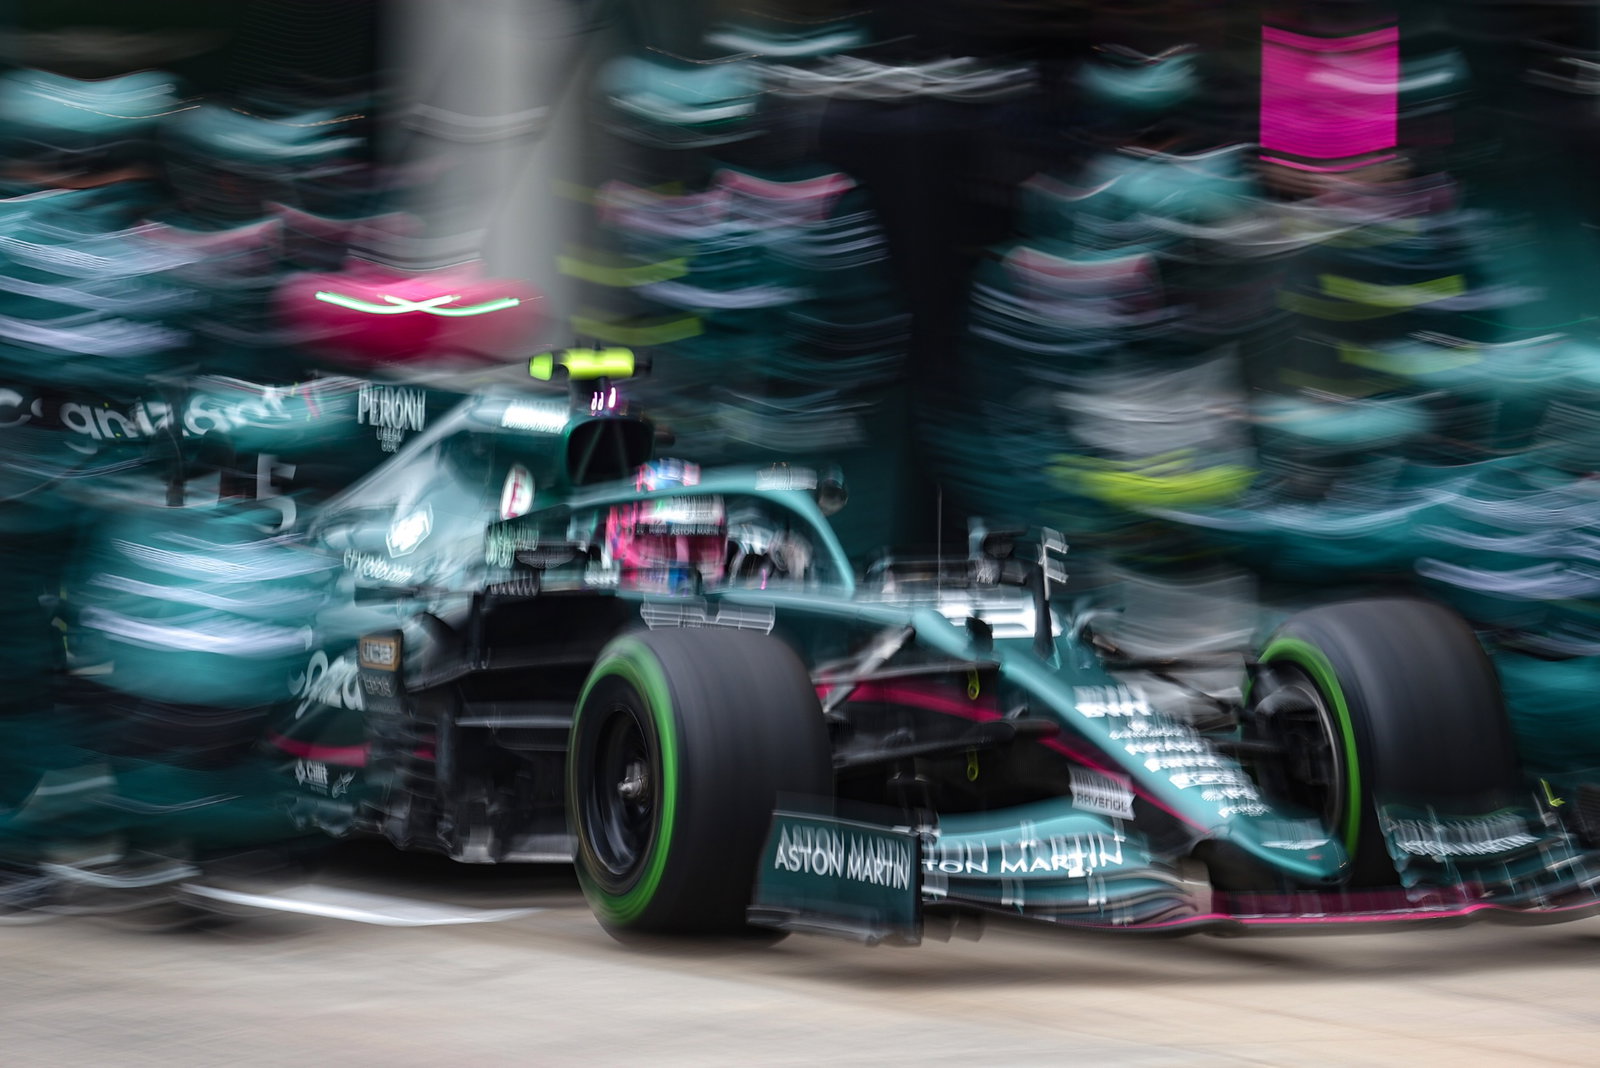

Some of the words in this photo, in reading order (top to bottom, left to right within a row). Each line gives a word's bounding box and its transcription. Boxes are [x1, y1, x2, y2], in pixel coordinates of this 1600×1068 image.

[357, 386, 426, 431] PERONI
[774, 830, 844, 878] ASTON
[847, 838, 911, 891] MARTIN
[1000, 840, 1121, 874] MARTIN
